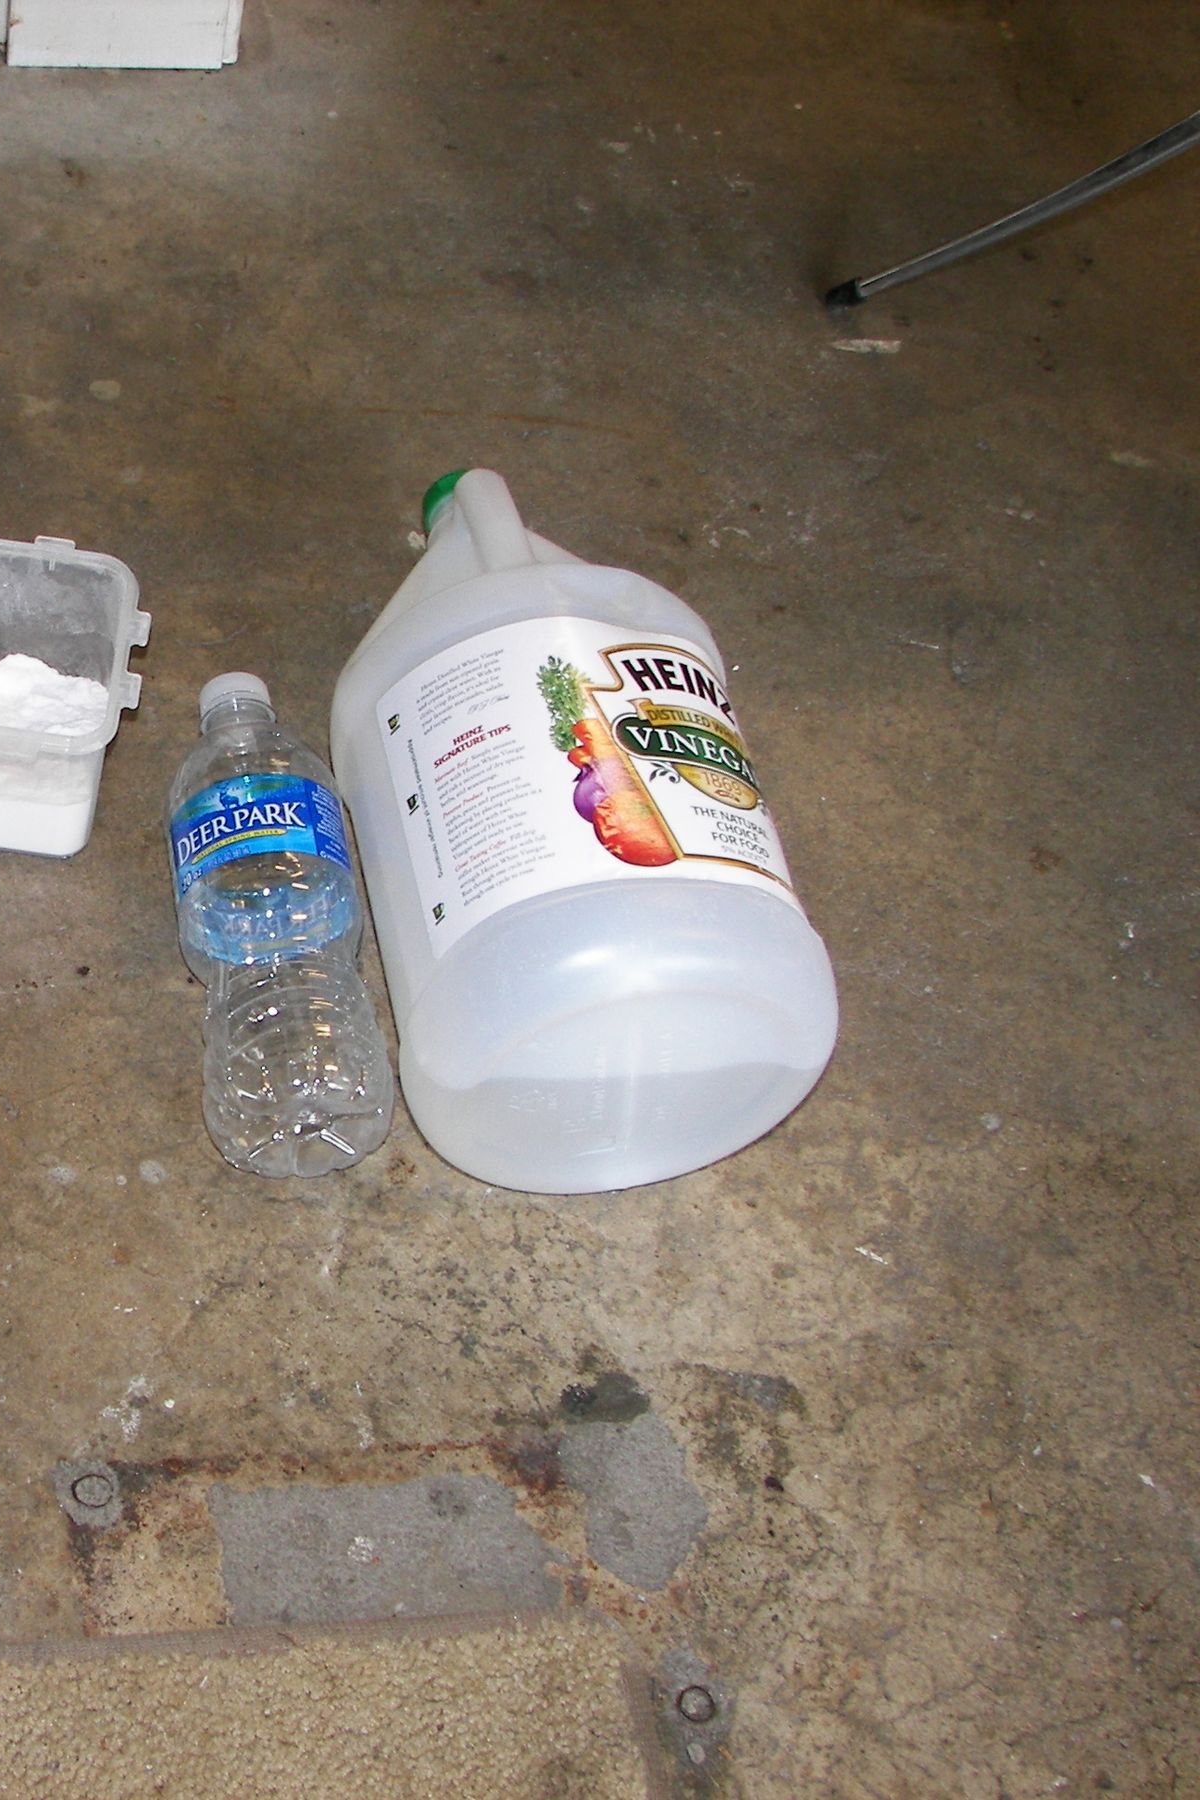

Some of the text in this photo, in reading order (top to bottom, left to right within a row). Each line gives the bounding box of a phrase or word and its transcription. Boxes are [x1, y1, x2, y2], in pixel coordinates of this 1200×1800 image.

[621, 658, 735, 726] HEINZ
[646, 708, 711, 728] DISTILLED
[433, 734, 486, 769] SIGNATURE
[487, 724, 511, 738] TIPS
[452, 725, 484, 746] HEINZ
[625, 725, 757, 785] VINEGA
[701, 771, 742, 797] 1869
[176, 816, 233, 866] DEER
[232, 801, 306, 830] PARK
[690, 805, 770, 840] THE NATURAL
[716, 821, 760, 844] CHOICE
[711, 832, 770, 858] FOR FOOD
